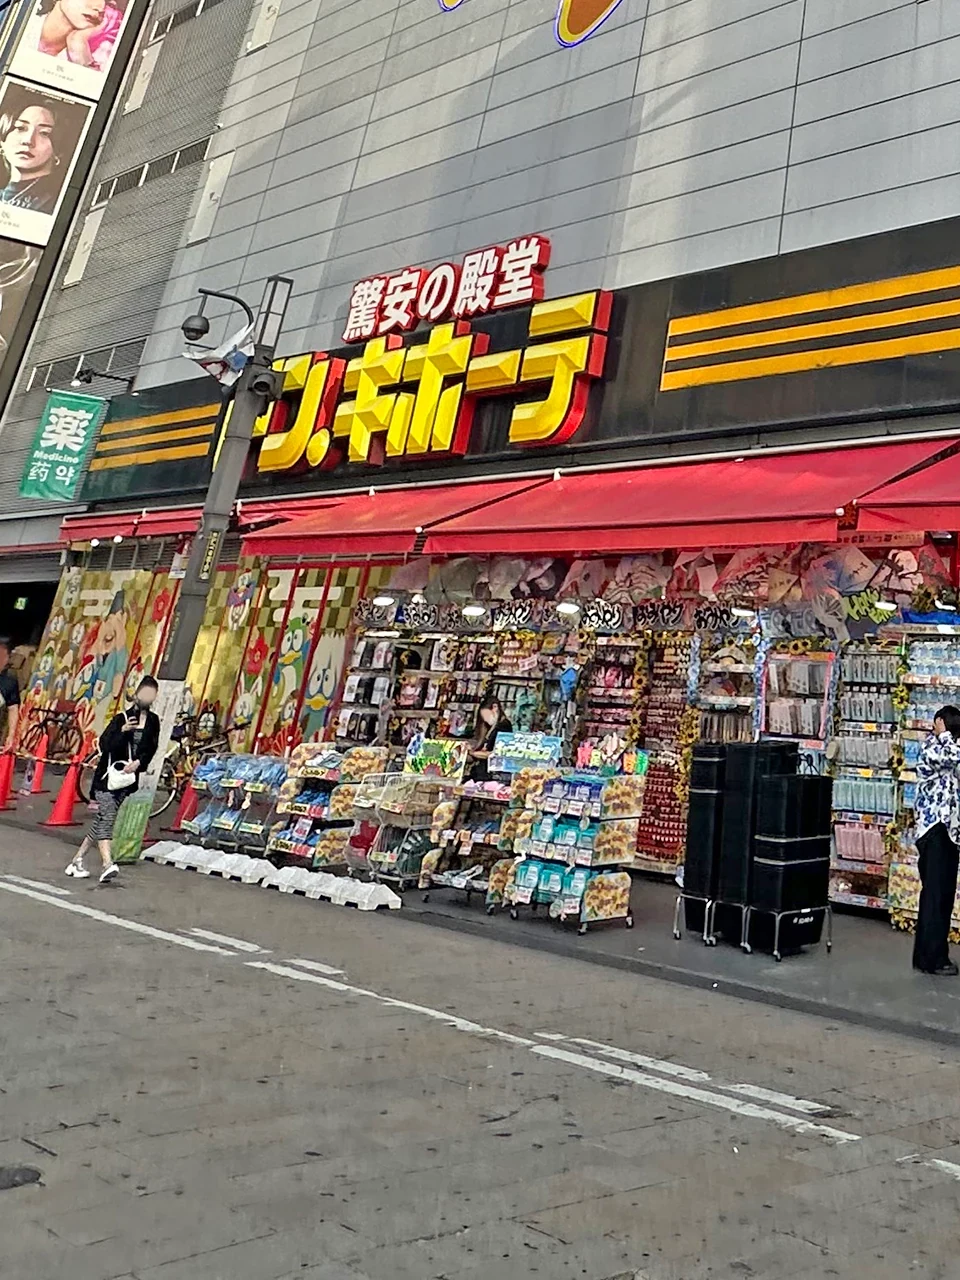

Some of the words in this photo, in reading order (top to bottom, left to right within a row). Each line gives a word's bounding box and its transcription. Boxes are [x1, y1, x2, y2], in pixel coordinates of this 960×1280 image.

[342, 235, 545, 341] 驚安の殿堂
[40, 407, 94, 451] 薬
[33, 450, 79, 464] Medicine
[28, 461, 52, 482] 药
[55, 466, 75, 486] 약
